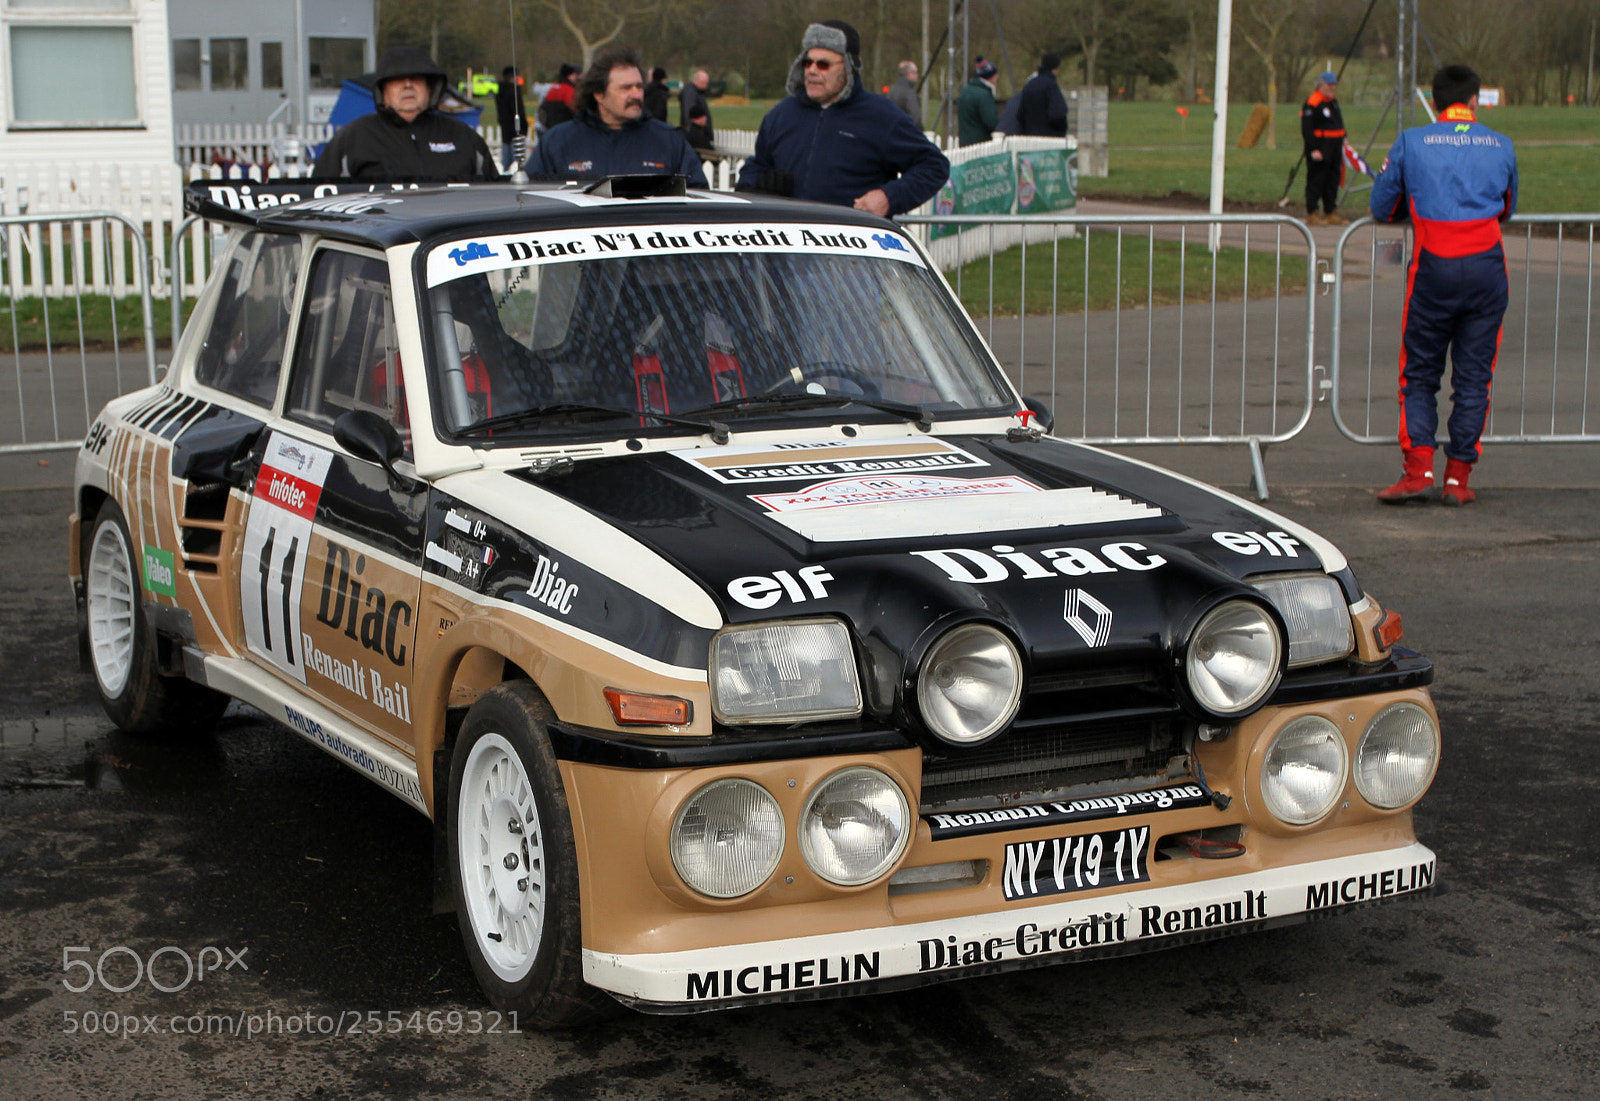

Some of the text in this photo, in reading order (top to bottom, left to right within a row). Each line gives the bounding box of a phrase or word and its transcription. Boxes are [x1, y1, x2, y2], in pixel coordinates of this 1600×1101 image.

[504, 240, 586, 262] Diac
[647, 231, 692, 249] du
[693, 229, 794, 248] Crédit
[799, 229, 868, 250] Auto
[85, 421, 113, 456] elf
[728, 455, 966, 479] Credit Renault
[268, 472, 307, 510] infotec
[834, 491, 899, 499] TOUR
[938, 482, 1014, 491] CORSE
[909, 542, 1168, 585] Diac
[1211, 531, 1300, 558] elf
[146, 553, 172, 588] Valeo
[526, 554, 579, 615] Diac
[727, 564, 835, 610] elf
[258, 526, 299, 667] 11
[316, 539, 412, 667] Diac
[302, 632, 412, 725] Renault Bail
[284, 704, 326, 744] PHILIPS
[326, 733, 375, 773] autoradio
[930, 801, 1049, 829] Renault
[1305, 860, 1434, 911] MICHELIN
[917, 889, 1268, 972] Diac Crédit Renault
[685, 951, 881, 1000] MICHELIN
